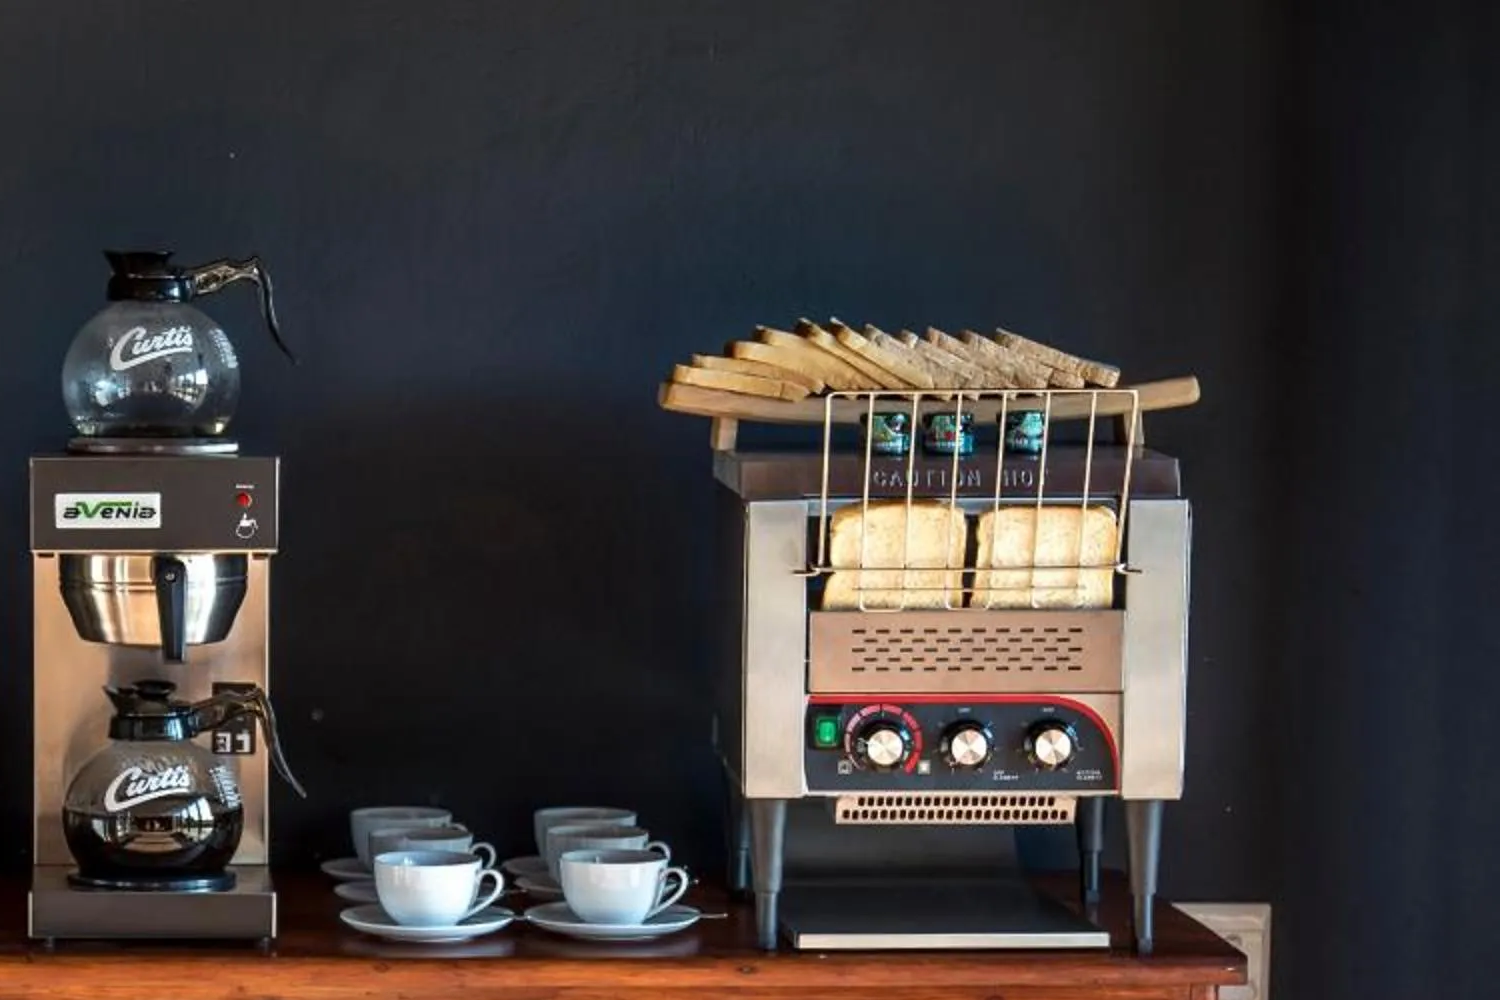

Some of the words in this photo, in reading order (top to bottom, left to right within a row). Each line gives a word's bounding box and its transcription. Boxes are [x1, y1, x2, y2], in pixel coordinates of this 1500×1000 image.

[110, 325, 192, 370] Curtis
[1003, 468, 1048, 487] HO
[104, 765, 190, 812] Curtis
